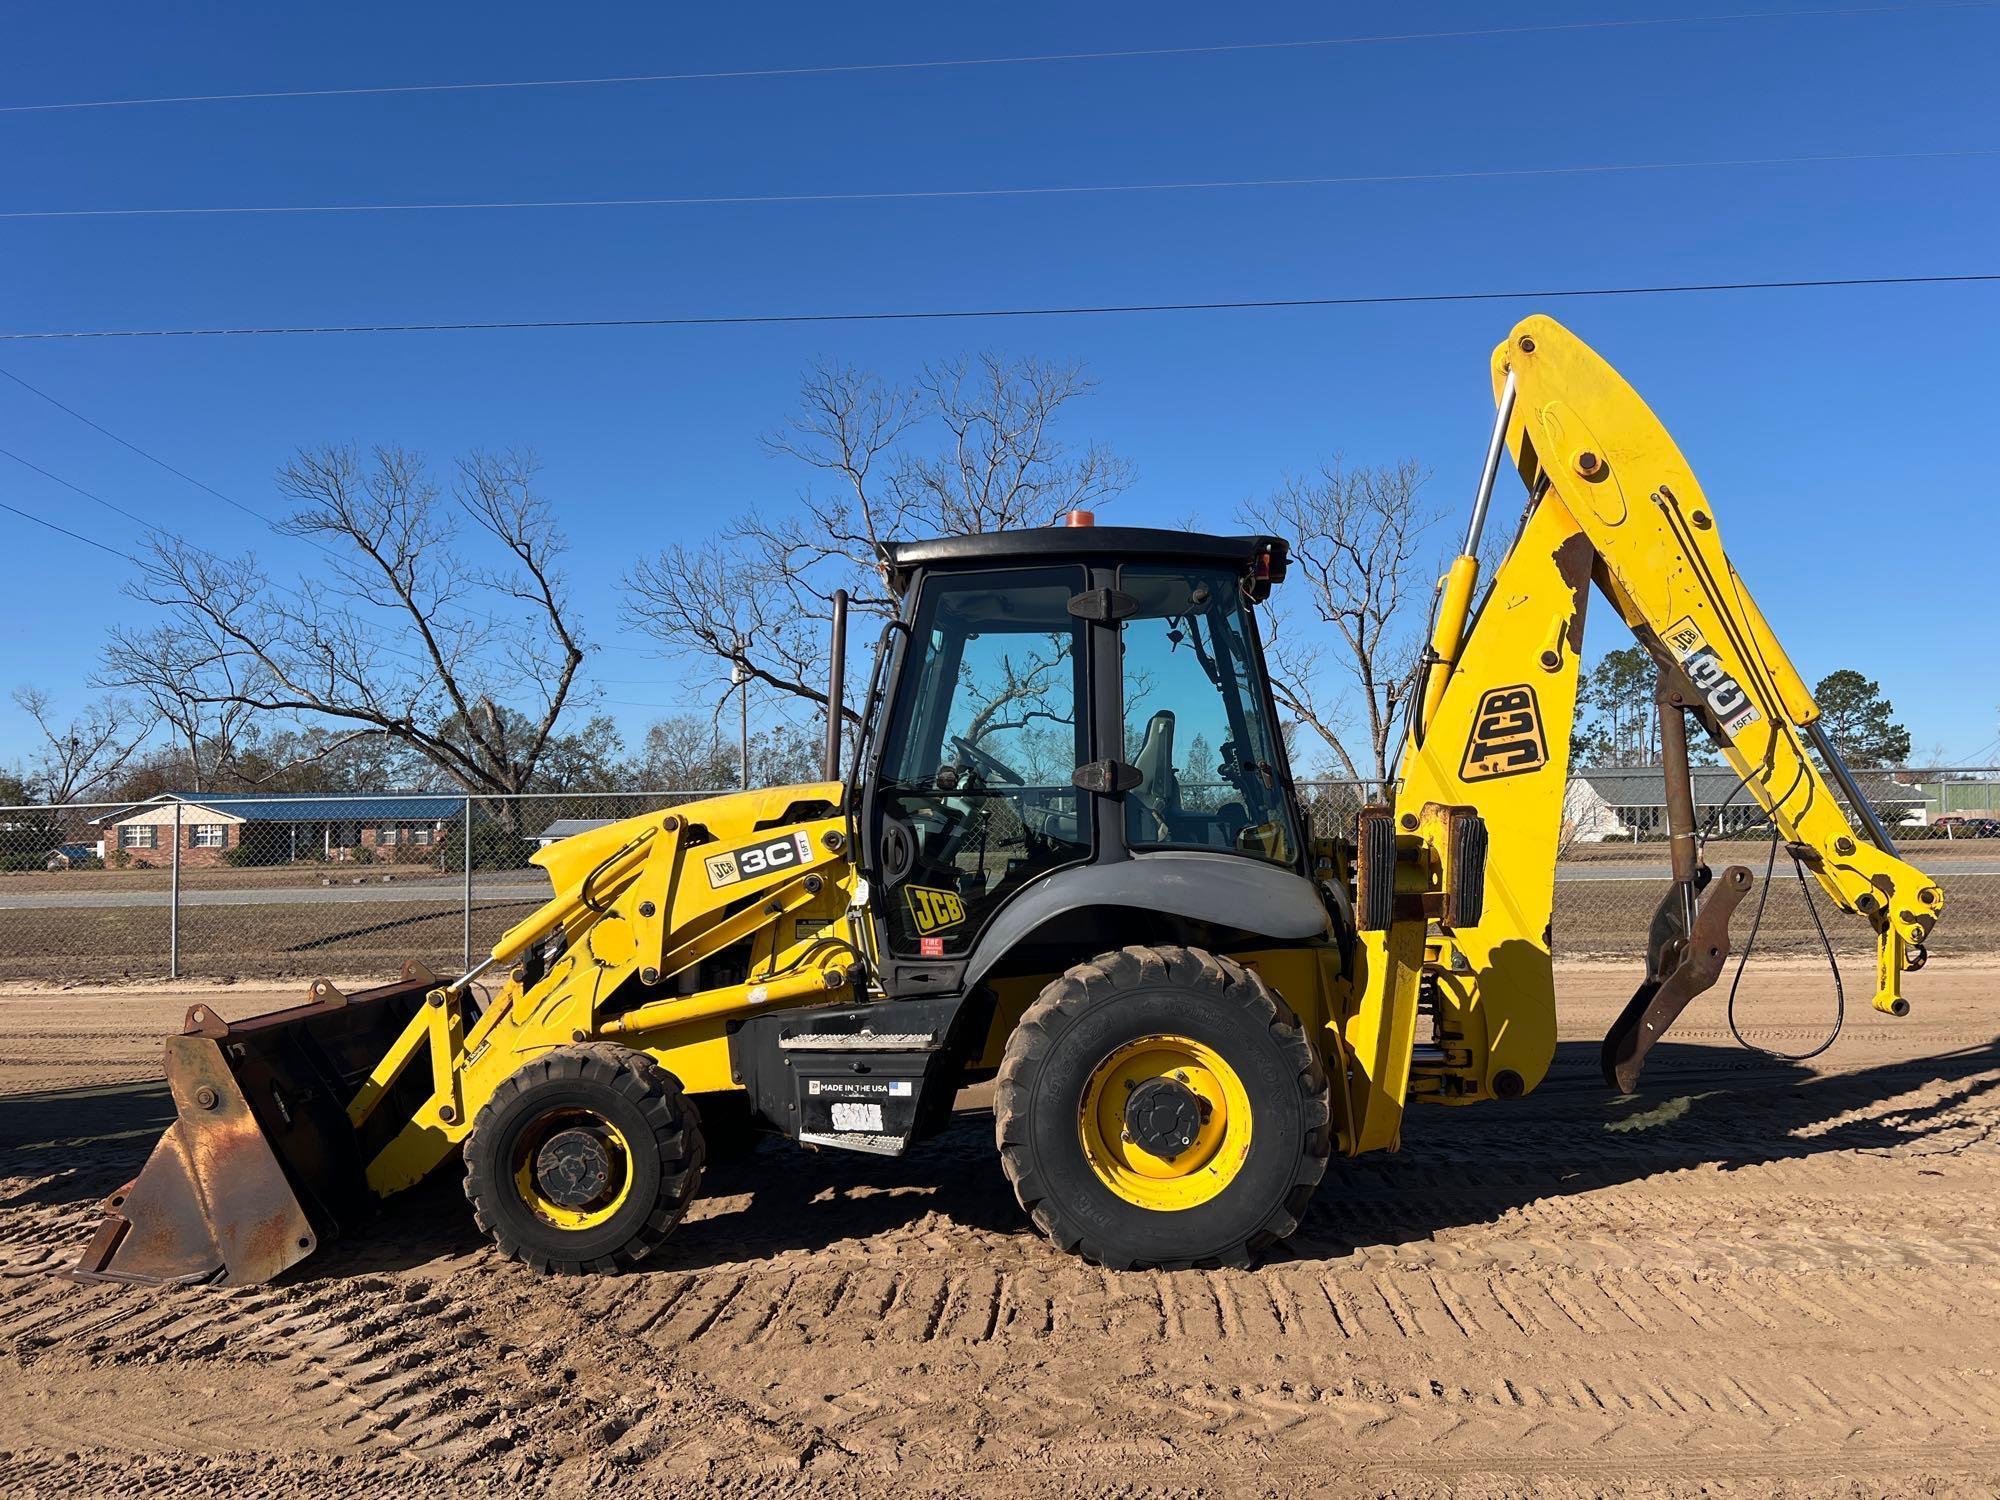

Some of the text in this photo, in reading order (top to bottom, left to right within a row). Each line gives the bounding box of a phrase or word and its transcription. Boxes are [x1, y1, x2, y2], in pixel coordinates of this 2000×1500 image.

[1672, 629, 1697, 652] JCB
[1688, 654, 1746, 716] 3C
[1470, 690, 1539, 767] JCB
[1731, 711, 1754, 731] 15FT
[713, 861, 736, 879] JCB
[740, 841, 794, 873] 3C
[915, 889, 962, 930] JCB
[820, 1084, 843, 1092] MADE
[844, 1084, 854, 1092] IN
[855, 1084, 871, 1092] THE
